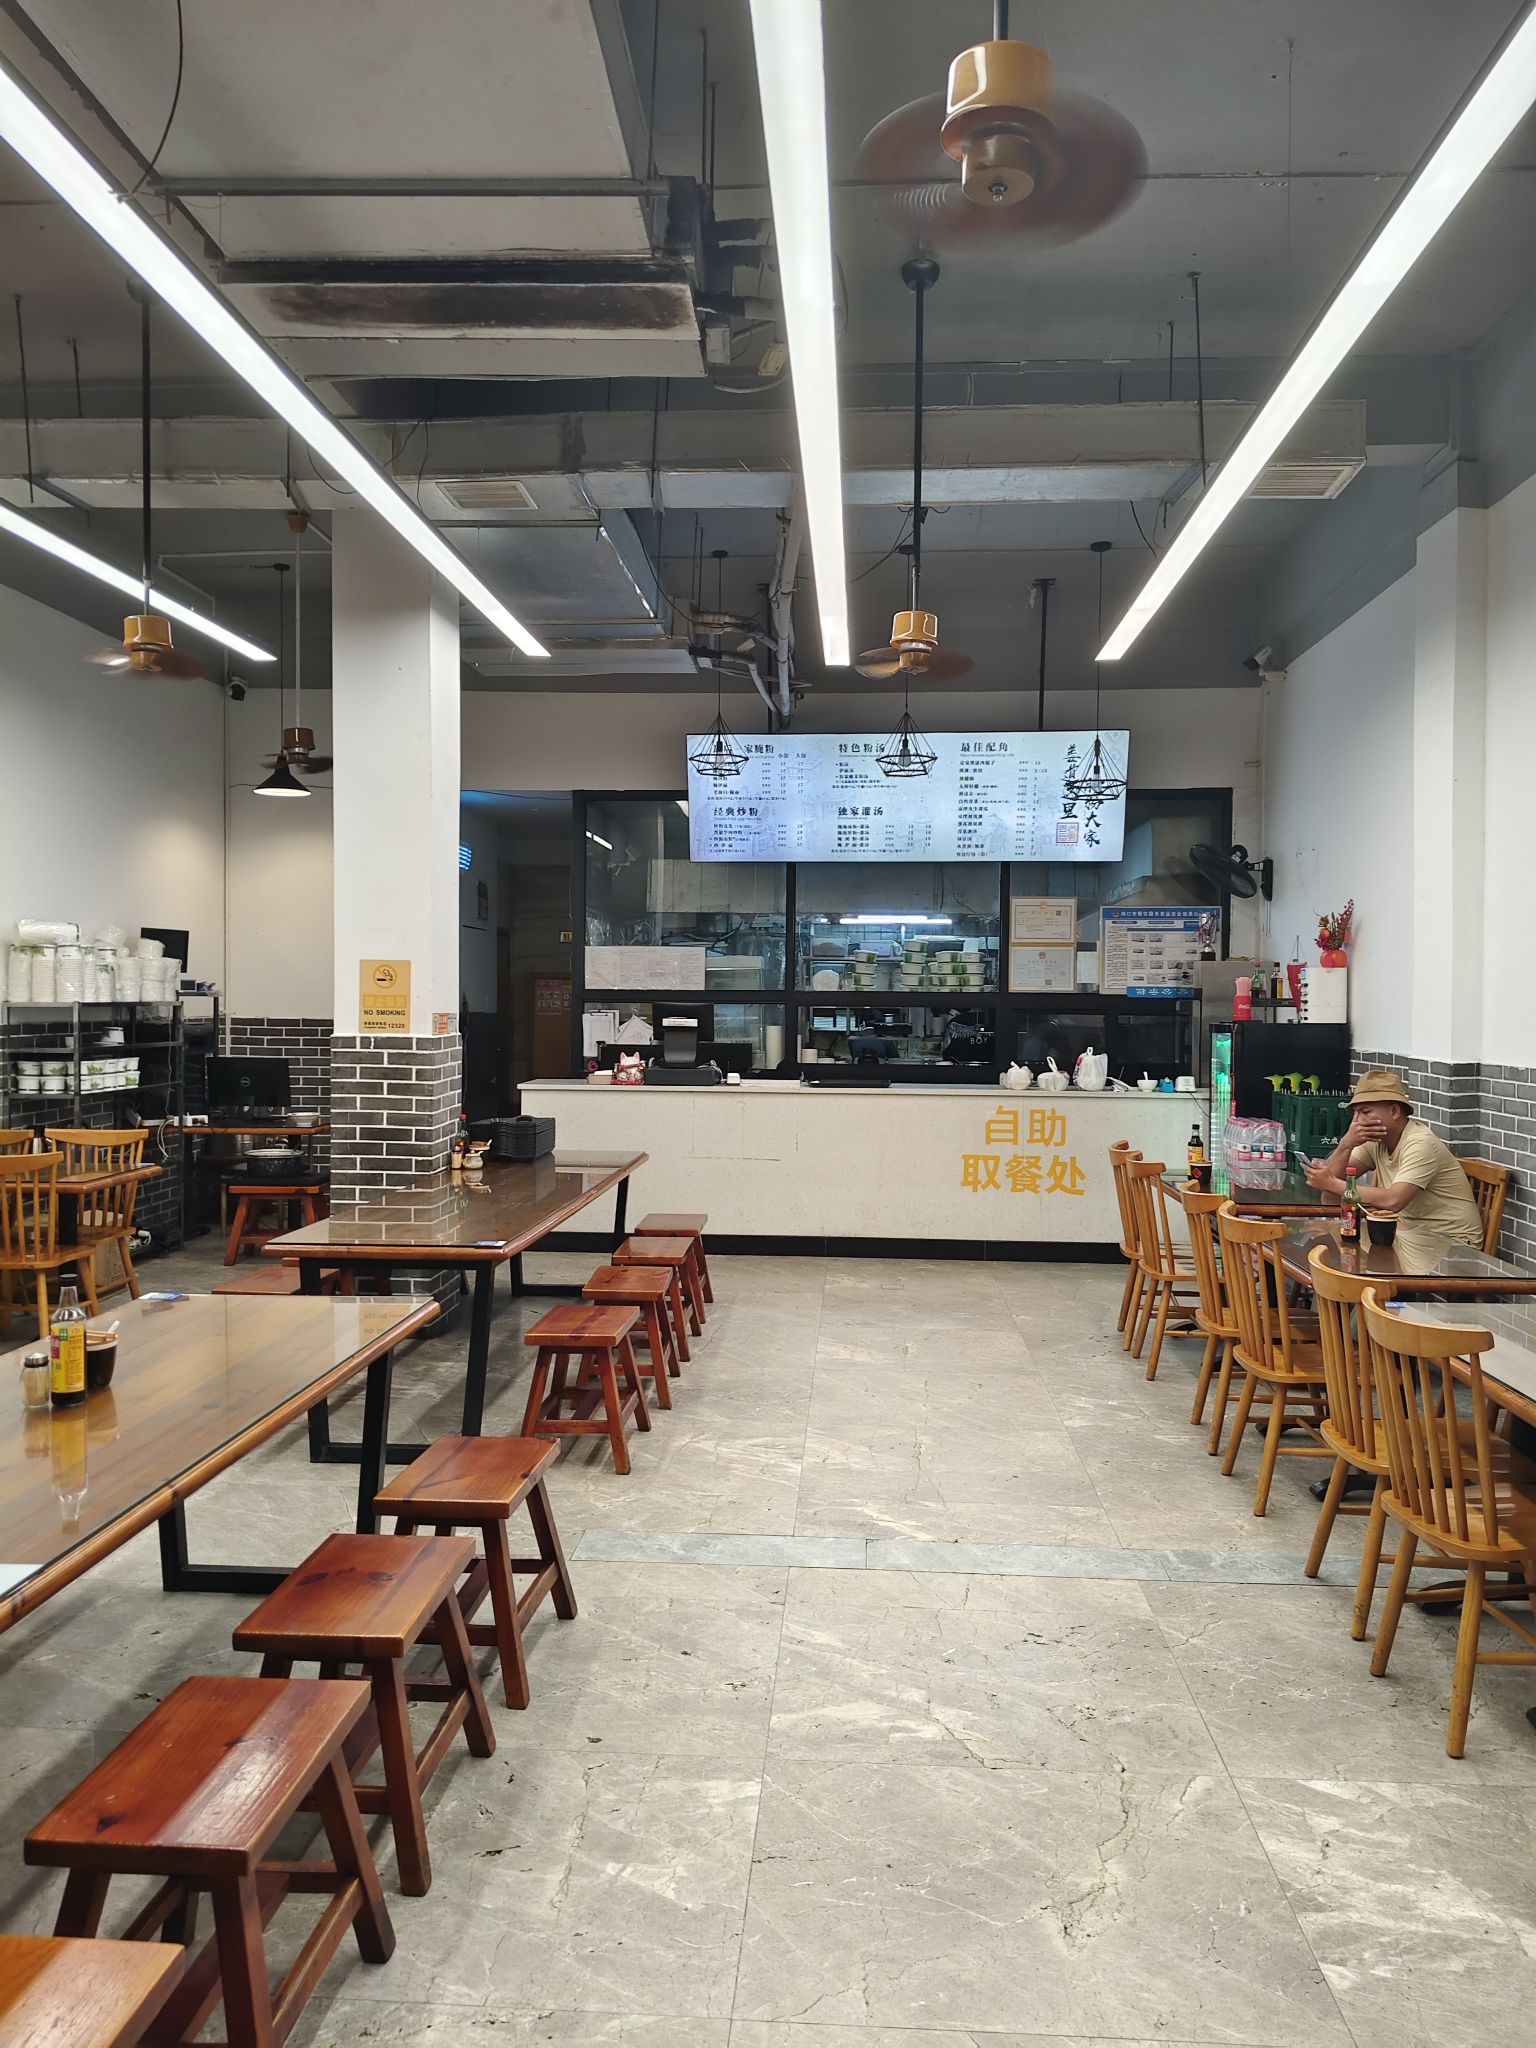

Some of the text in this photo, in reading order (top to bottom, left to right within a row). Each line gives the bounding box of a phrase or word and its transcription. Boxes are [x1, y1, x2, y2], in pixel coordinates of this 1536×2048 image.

[985, 1105, 1067, 1147] 自助
[1321, 1136, 1342, 1145] 六点
[960, 1154, 1087, 1196] 取餐处
